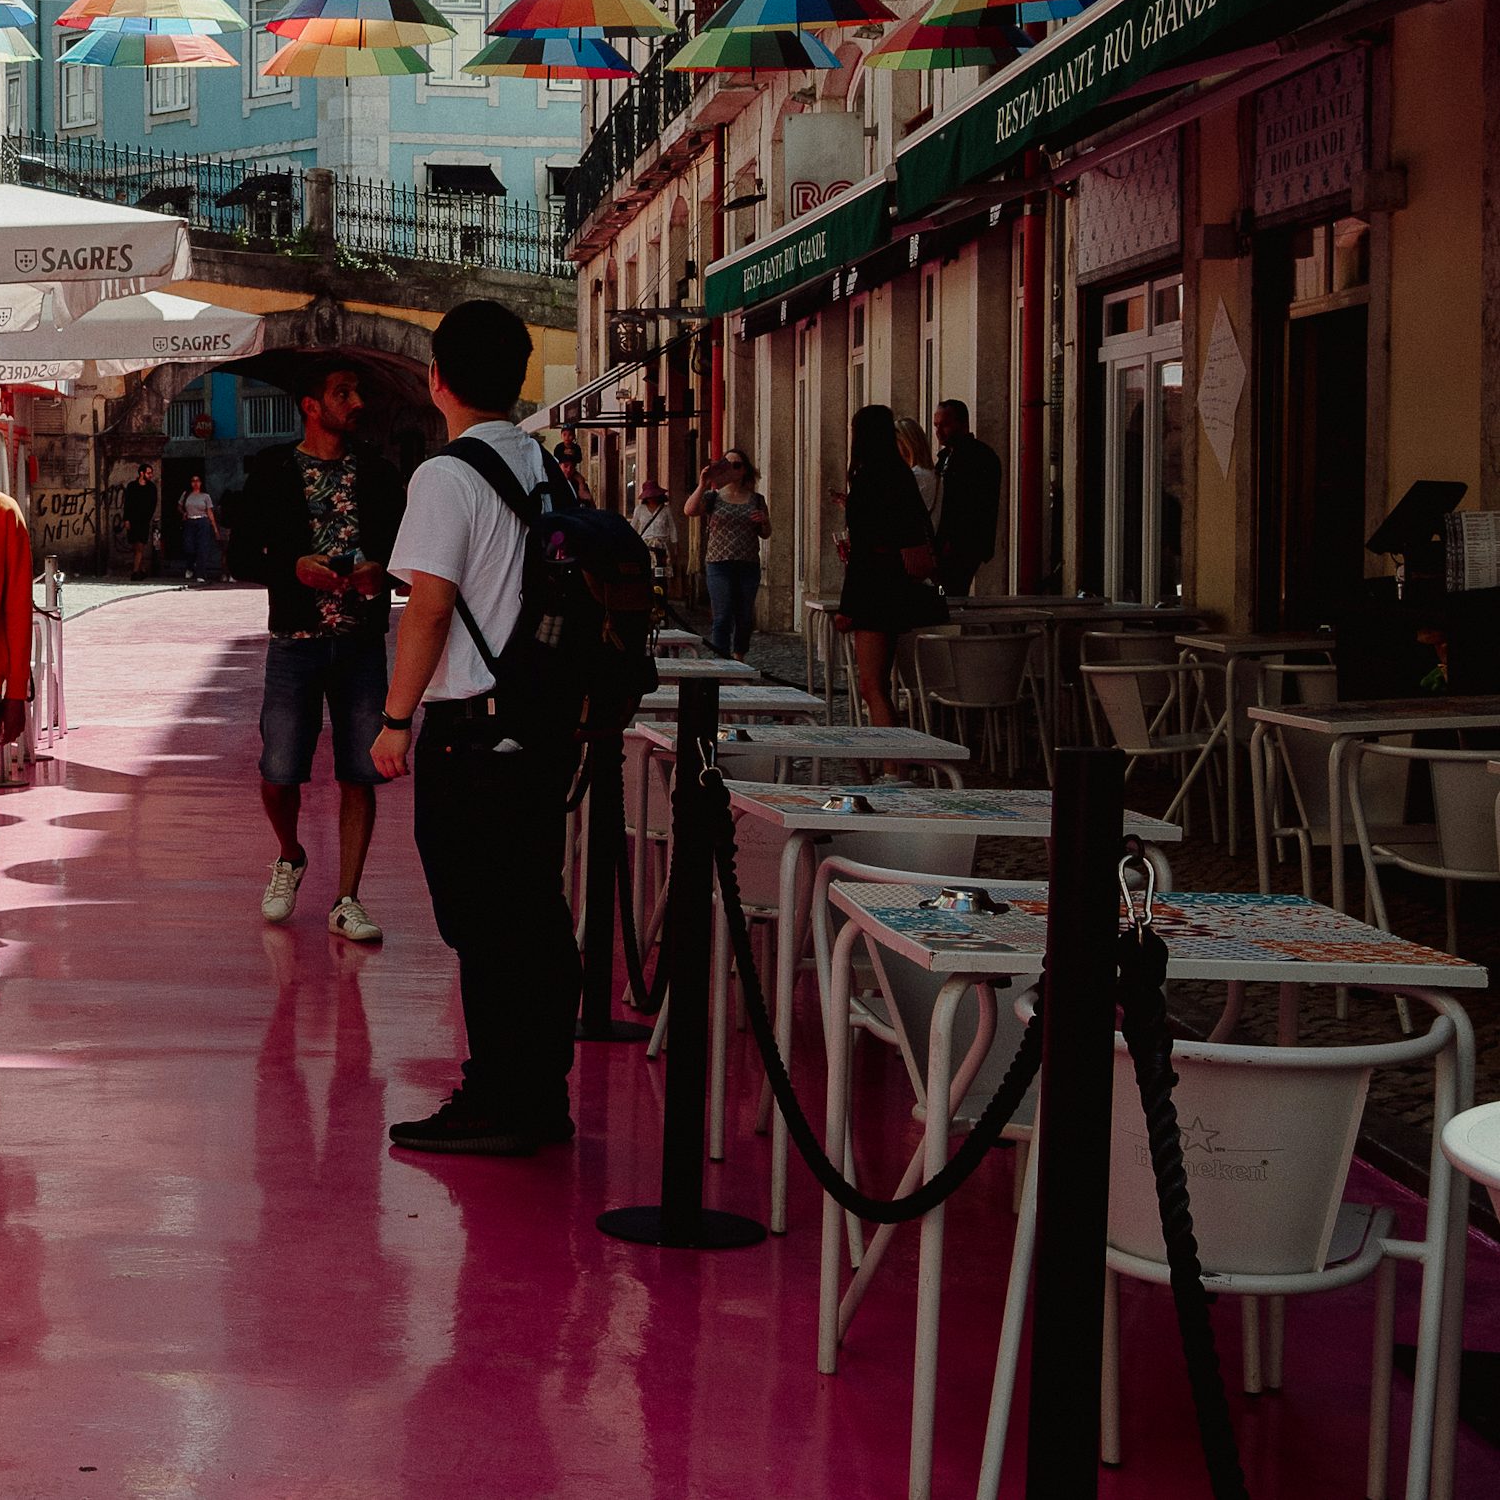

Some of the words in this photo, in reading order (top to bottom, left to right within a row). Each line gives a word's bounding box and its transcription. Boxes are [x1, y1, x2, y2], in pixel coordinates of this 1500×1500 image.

[995, 44, 1097, 144] RESTAURANTE
[1100, 18, 1134, 77] RIO
[1266, 91, 1352, 147] RESTAURANTE
[1270, 150, 1291, 177] RIO
[1296, 128, 1346, 167] GRANDE
[41, 244, 133, 273] SAGRES
[170, 333, 232, 352] SAGRES
[1134, 1143, 1268, 1182] Hneken
